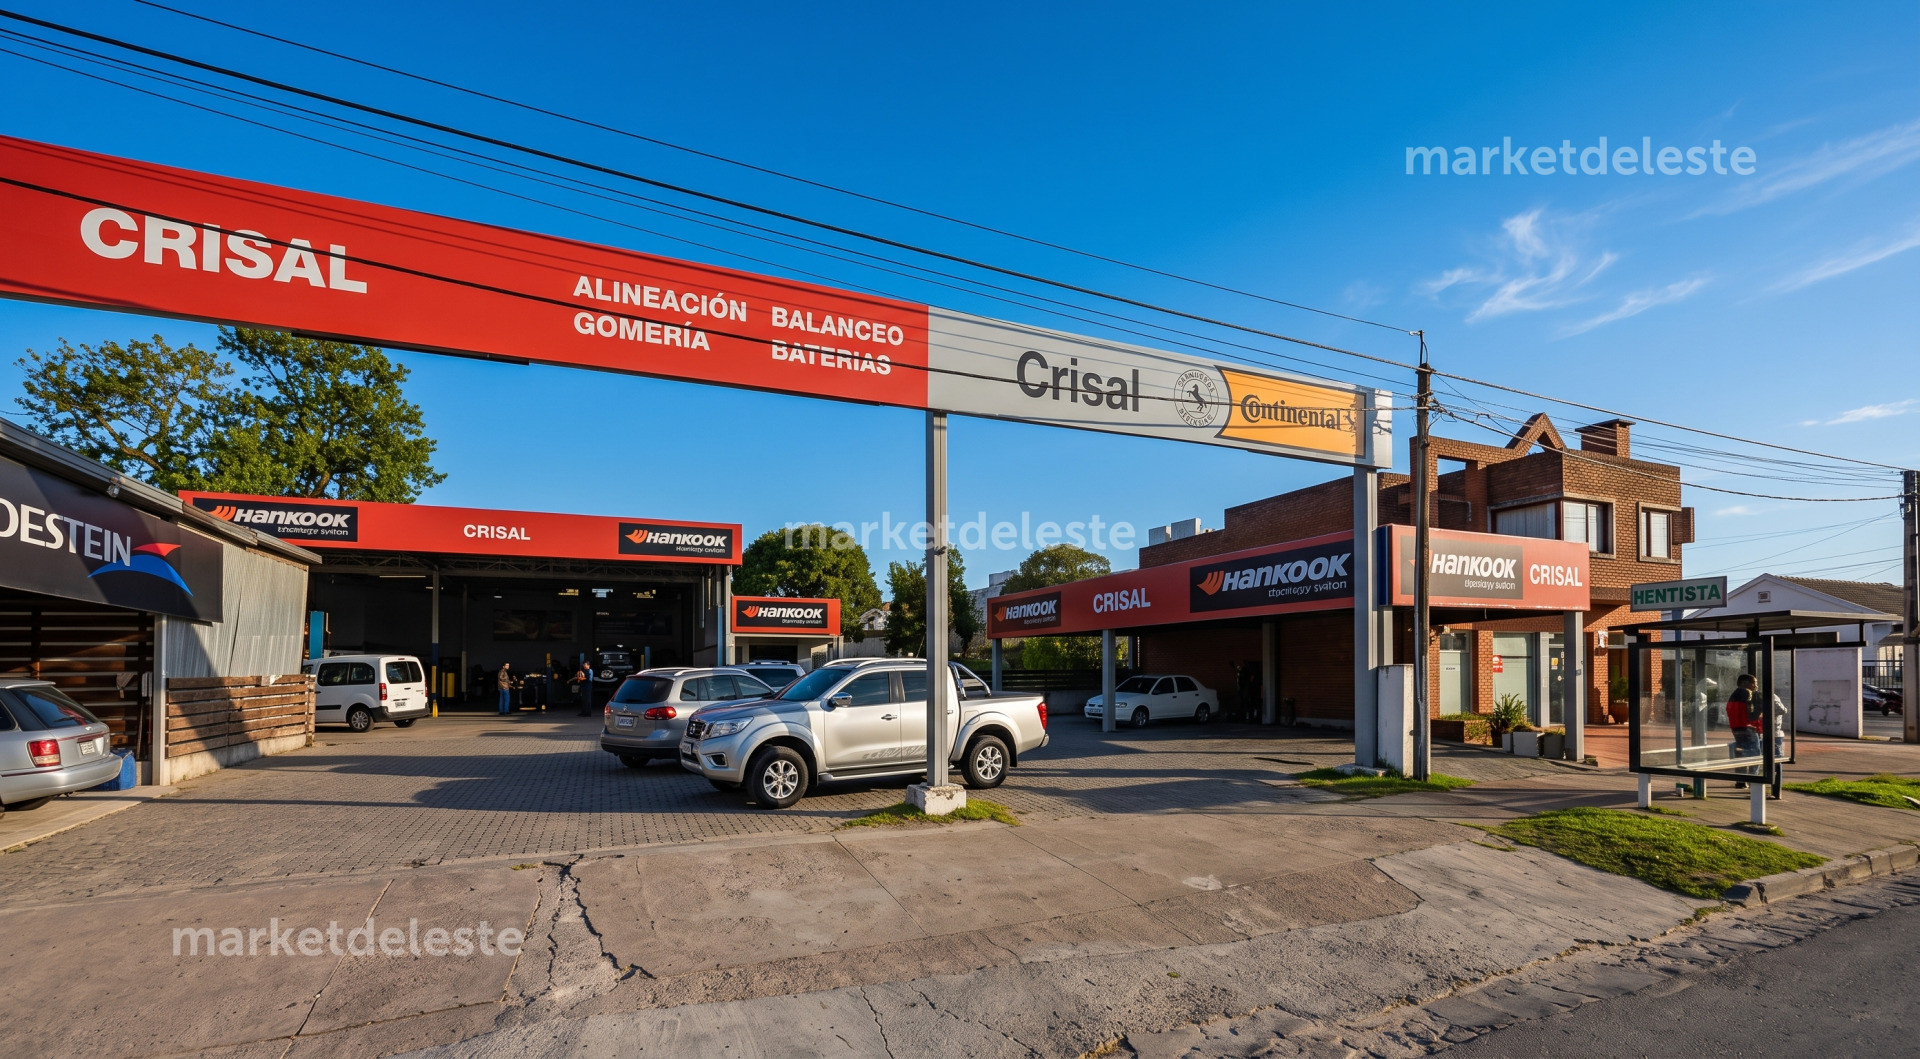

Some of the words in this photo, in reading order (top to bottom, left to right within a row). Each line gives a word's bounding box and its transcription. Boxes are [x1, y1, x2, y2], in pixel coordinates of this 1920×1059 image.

[80, 207, 368, 294] CRISAL
[573, 275, 748, 322] ALINEACIÓN
[771, 306, 904, 346] BALANCEO
[573, 311, 711, 351] GOMERÍA
[771, 339, 892, 375] BATERIAS
[1016, 350, 1140, 413] Crisal
[1240, 394, 1341, 431] Continental
[463, 524, 531, 541] CRISAL
[1529, 563, 1583, 587] CRISAL
[1093, 587, 1151, 614] CRISAL
[1633, 584, 1722, 605] HENTISTA
